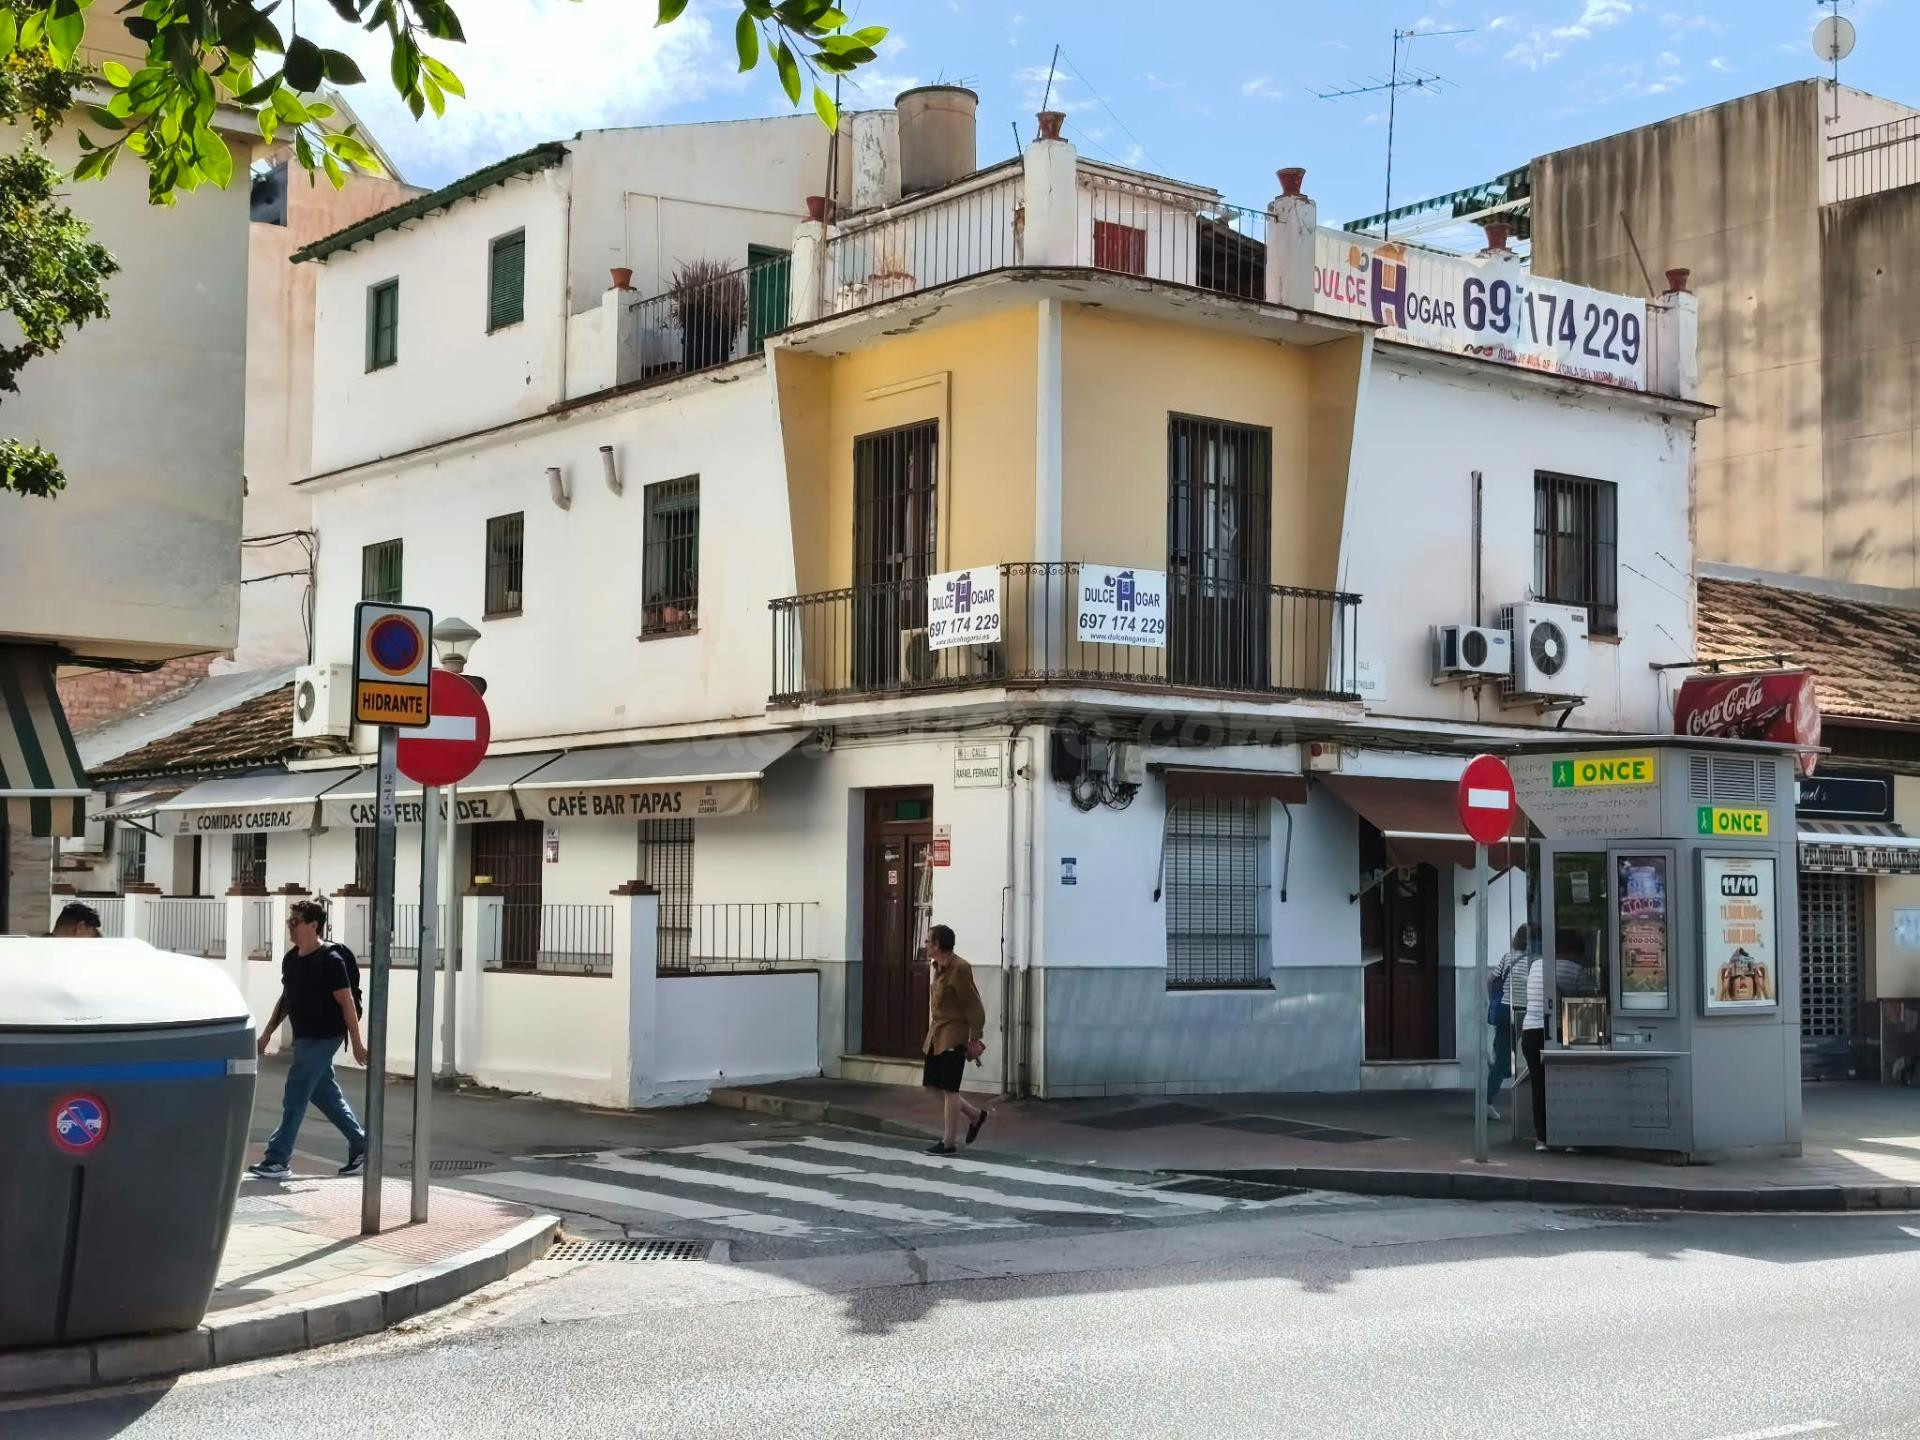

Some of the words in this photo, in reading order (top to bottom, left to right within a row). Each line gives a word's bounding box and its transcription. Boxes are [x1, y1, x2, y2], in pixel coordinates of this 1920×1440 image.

[1370, 257, 1457, 330] HOGAR
[1525, 291, 1578, 351] 174
[1583, 303, 1642, 366] 229
[932, 594, 954, 612] DULCE
[954, 580, 995, 613] HOGAR
[1085, 587, 1115, 604] DULCE
[1116, 580, 1160, 612] HOGAR
[929, 620, 946, 639] 697
[951, 617, 971, 634] 174
[975, 614, 999, 631] 229
[1079, 613, 1107, 630] 697
[1111, 616, 1136, 632] 174
[1141, 618, 1165, 635] 229
[362, 692, 422, 714] HIDRANTE
[971, 747, 987, 758] CALLE
[1581, 761, 1646, 782] ONCE
[351, 803, 377, 823] CAS
[548, 791, 587, 817] CAFÉ
[593, 795, 625, 815] BAR
[630, 792, 682, 814] TAPAS
[197, 813, 243, 830] COMIDAS
[246, 811, 292, 829] CASERAS
[1718, 811, 1763, 832] ONCE
[1857, 850, 1867, 867] DE
[1722, 877, 1758, 895] 11/11
